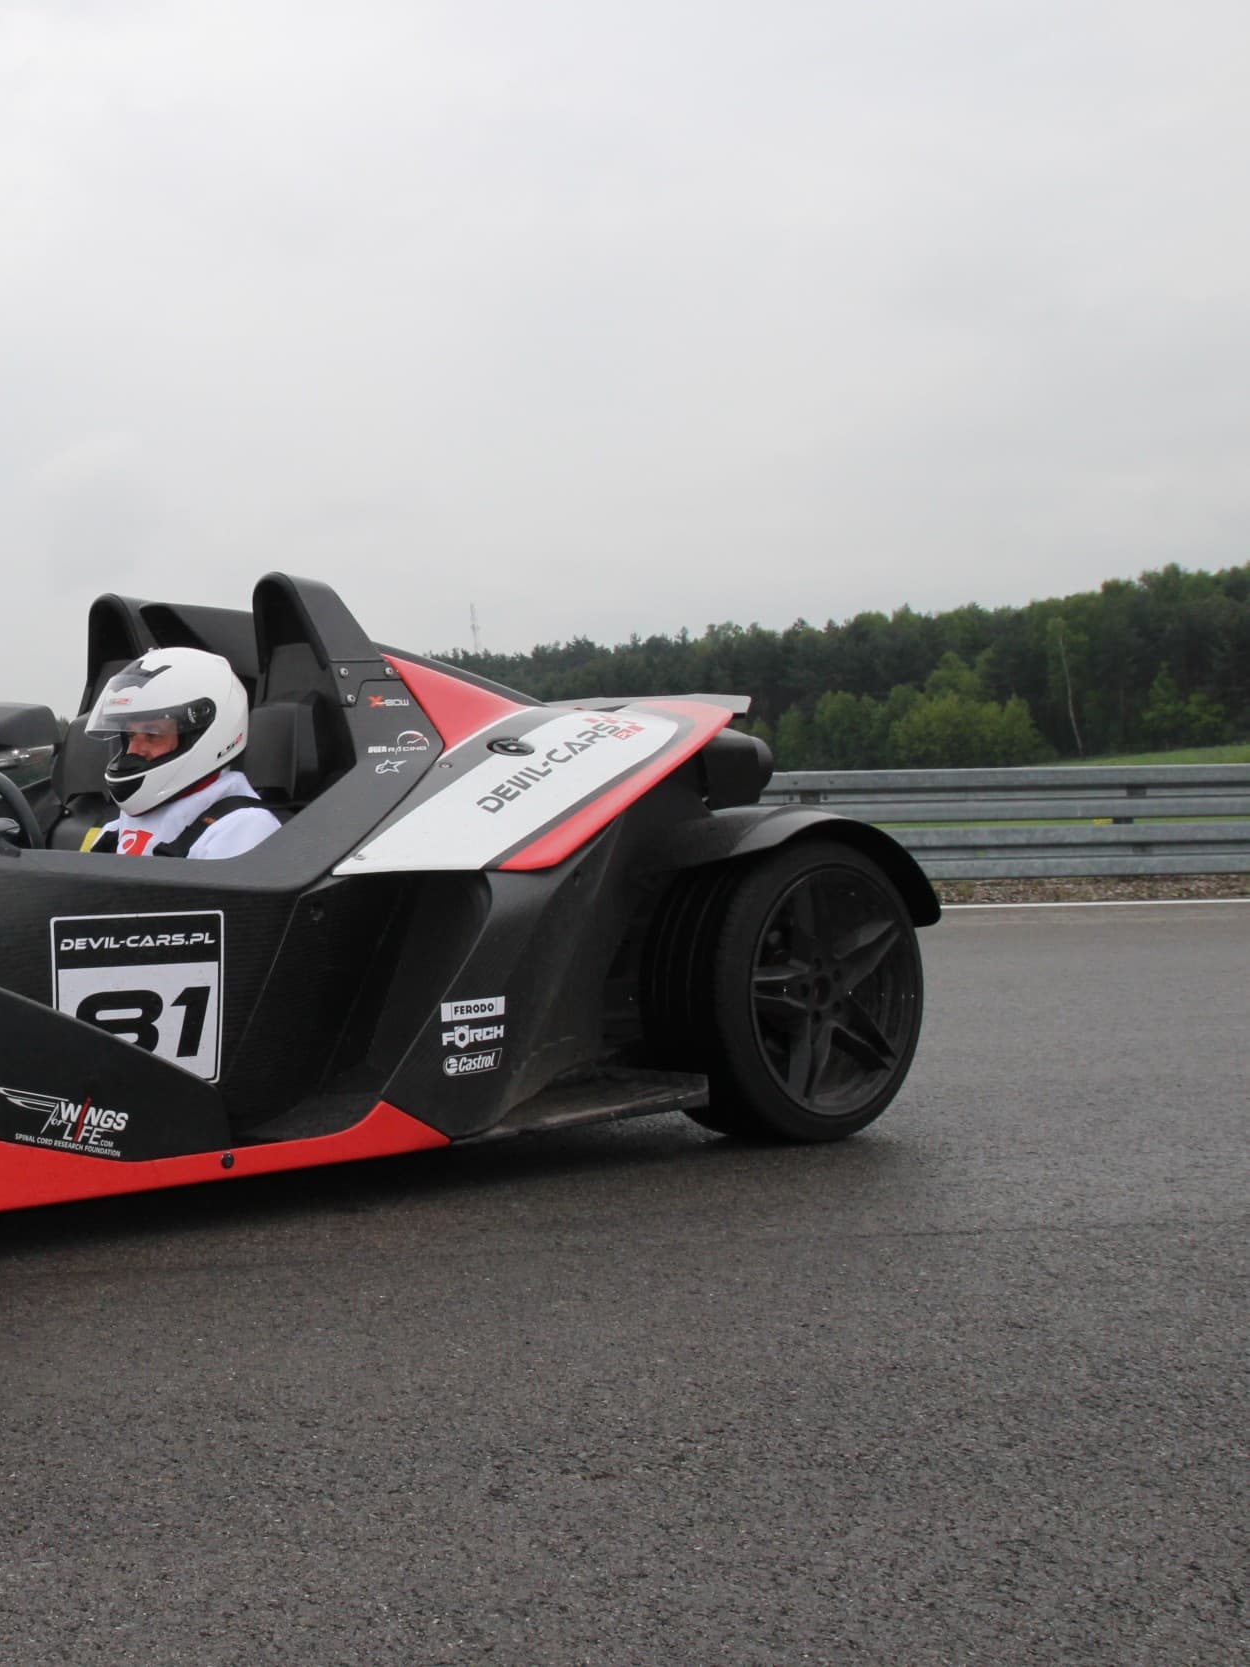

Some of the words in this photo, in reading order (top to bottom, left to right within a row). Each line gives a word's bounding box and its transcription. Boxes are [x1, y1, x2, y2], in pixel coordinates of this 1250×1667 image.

[476, 722, 621, 814] DEVIL-CARS
[60, 932, 216, 951] DEVIL-CARS.PL
[76, 986, 211, 1058] 81
[454, 1003, 495, 1016] FERODO
[458, 1052, 496, 1073] Castrol
[61, 1099, 129, 1131] WINGS
[15, 1133, 36, 1144] SPINAL
[36, 1137, 53, 1146] CORD
[53, 1139, 84, 1151] RESEARCH
[84, 1145, 121, 1158] FOUNDATION
